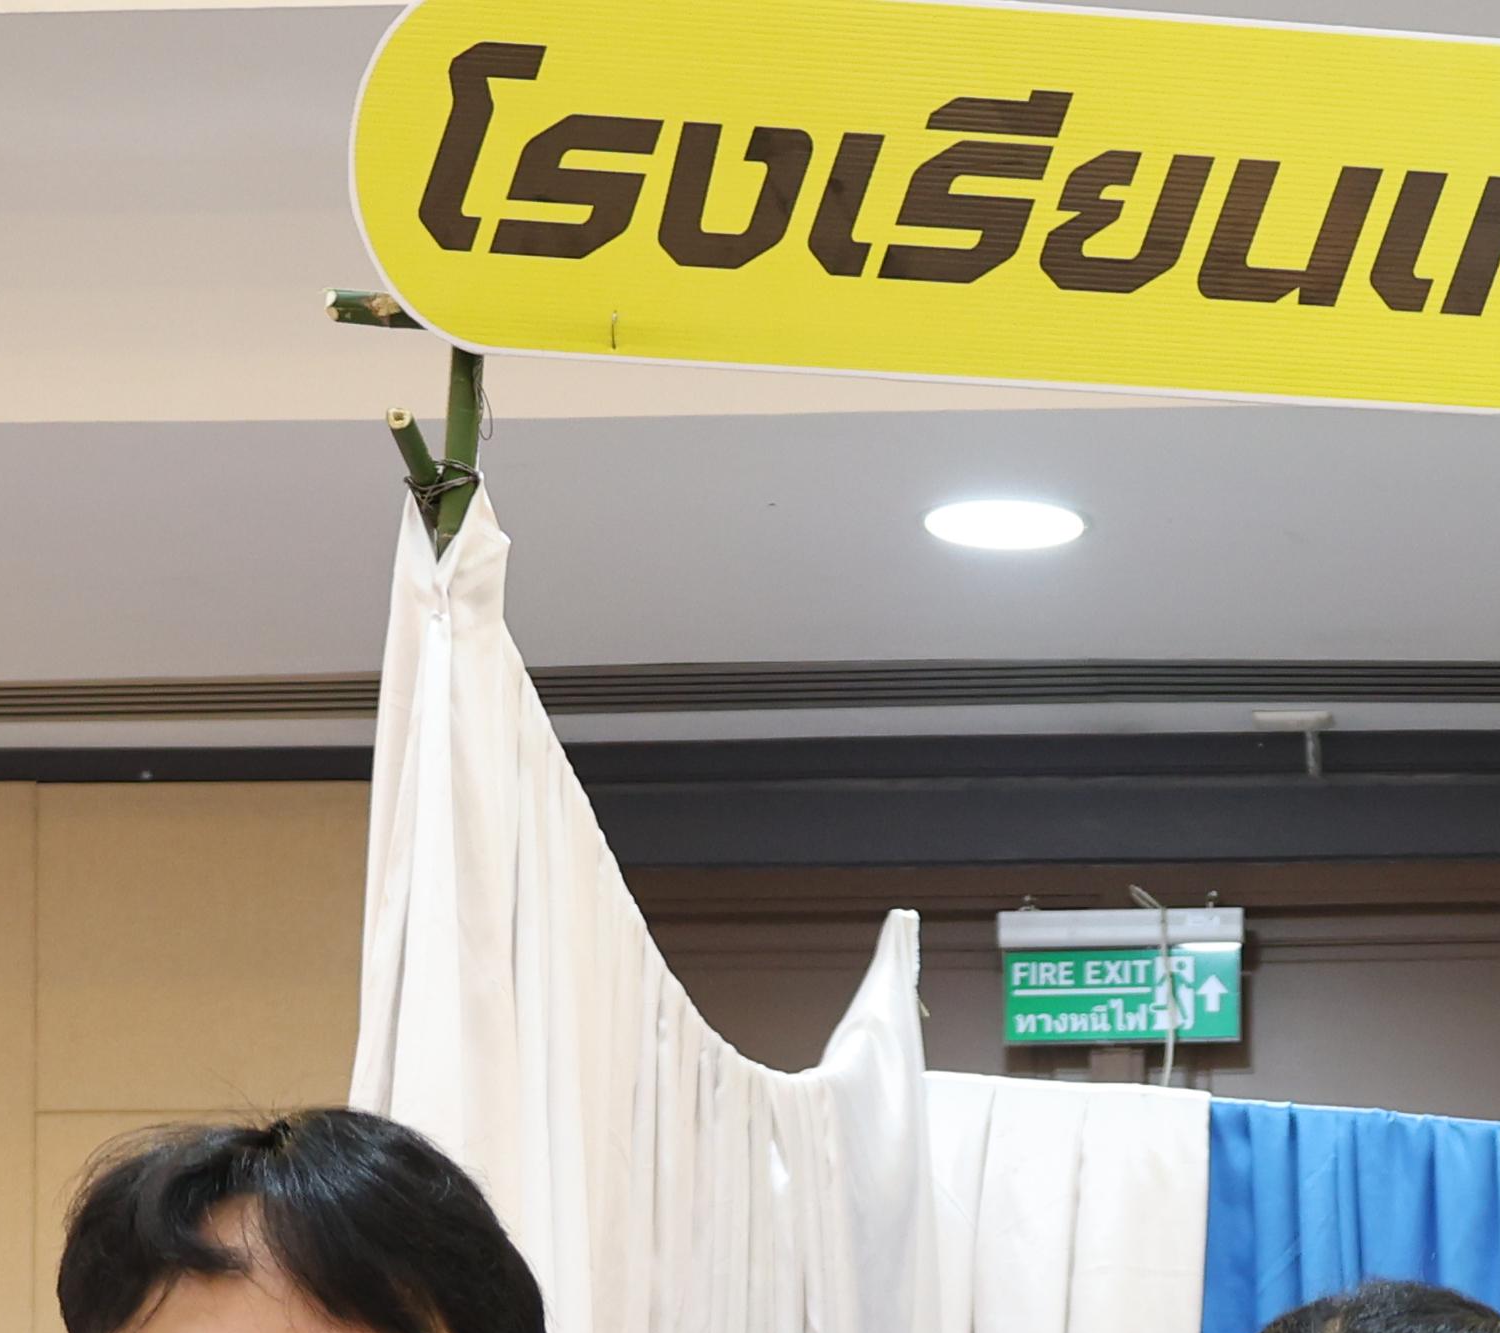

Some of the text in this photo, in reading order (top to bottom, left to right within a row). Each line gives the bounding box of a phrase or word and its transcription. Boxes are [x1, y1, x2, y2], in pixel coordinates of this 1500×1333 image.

[1012, 959, 1151, 987] FIRE EXIT
[1014, 999, 1148, 1034] ทางหนีไฟ
